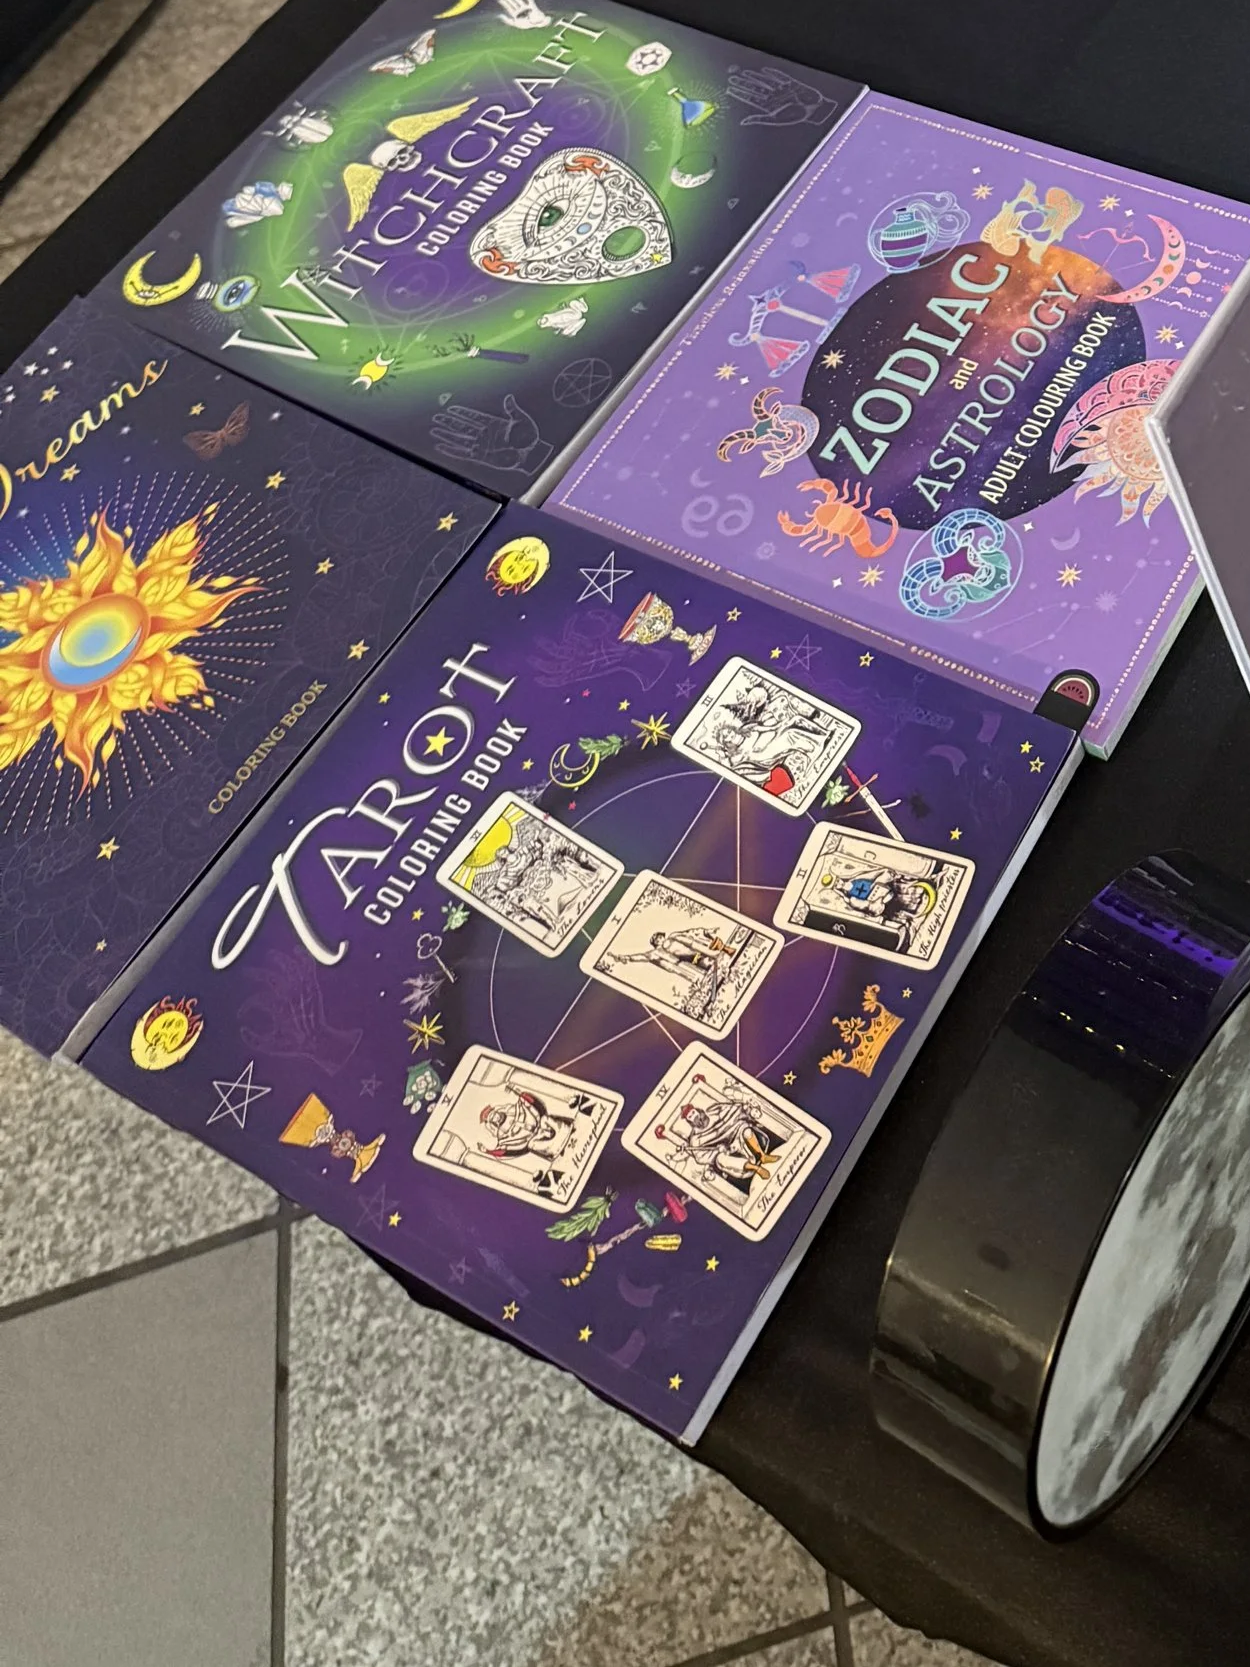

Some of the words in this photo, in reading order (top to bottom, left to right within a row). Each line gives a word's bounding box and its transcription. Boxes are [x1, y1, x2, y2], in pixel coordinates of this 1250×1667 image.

[218, 9, 608, 359] WITCHCRAFT
[414, 168, 510, 257] COLORING
[497, 119, 555, 169] BOOK
[817, 250, 1013, 477] ZODIAC
[909, 270, 1082, 513] ASTROLOGY
[944, 355, 981, 391] and
[976, 445, 1030, 505] ADULT
[1011, 353, 1090, 451] COLOURING
[1068, 309, 1117, 358] BOOK
[0, 356, 170, 517] reams
[204, 723, 288, 816] COLORING
[278, 676, 329, 729] BOOK
[210, 640, 516, 972] TAROT
[360, 789, 476, 928] COLORING
[459, 716, 530, 791] BOOK
[726, 942, 768, 999] Magician
[914, 937, 935, 958] The
[922, 909, 945, 937] High
[552, 1171, 578, 1198] The
[771, 1139, 808, 1188] Emperor
